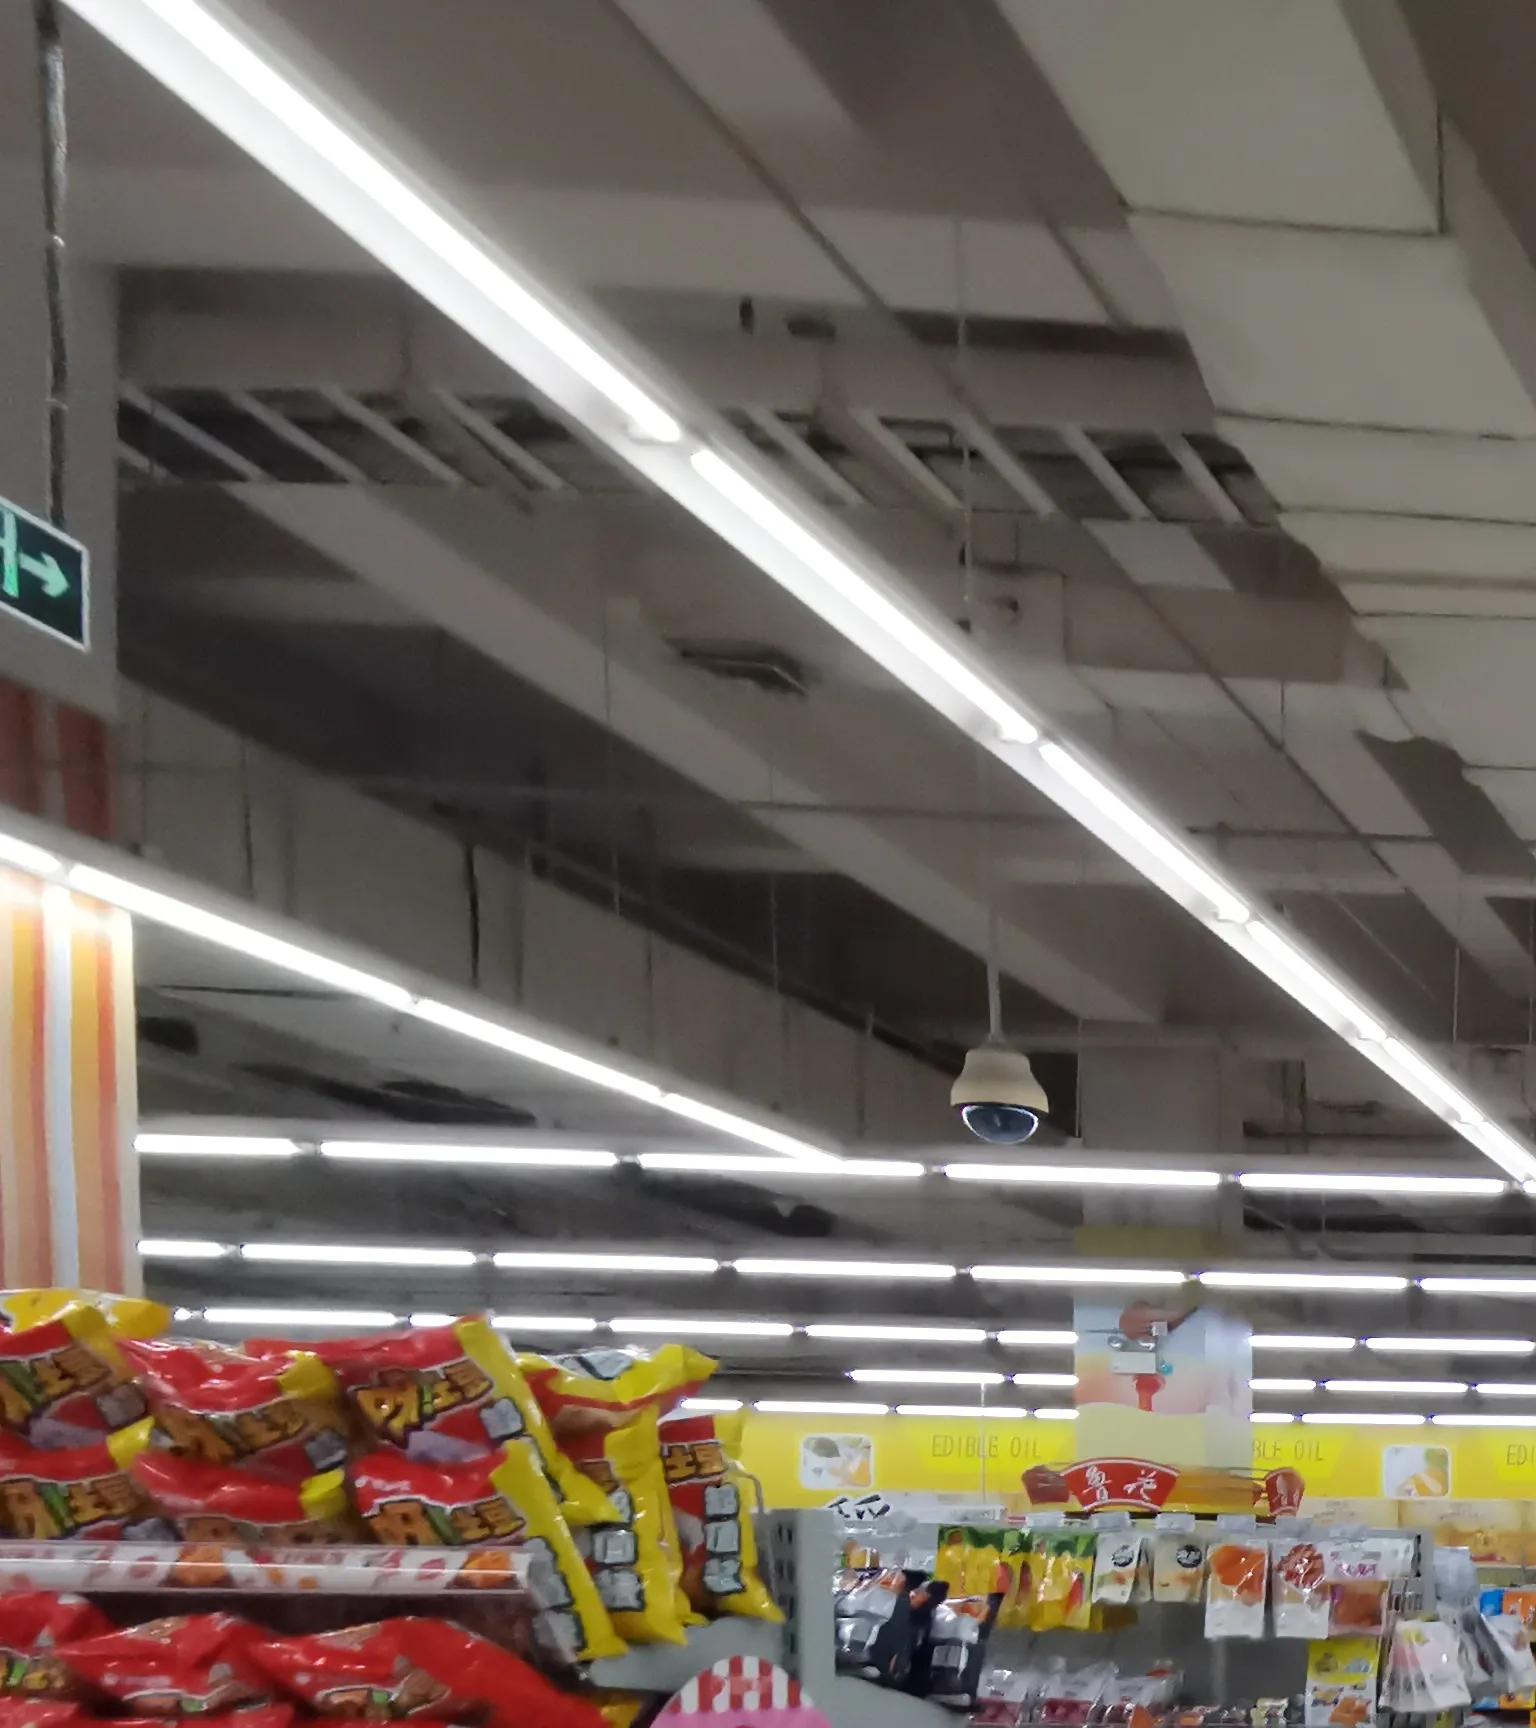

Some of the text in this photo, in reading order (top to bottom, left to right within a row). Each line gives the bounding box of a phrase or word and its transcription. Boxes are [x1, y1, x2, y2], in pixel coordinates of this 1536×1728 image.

[932, 1435, 1041, 1458] EDIBLE OIL
[1253, 1439, 1325, 1460] BLE OIL
